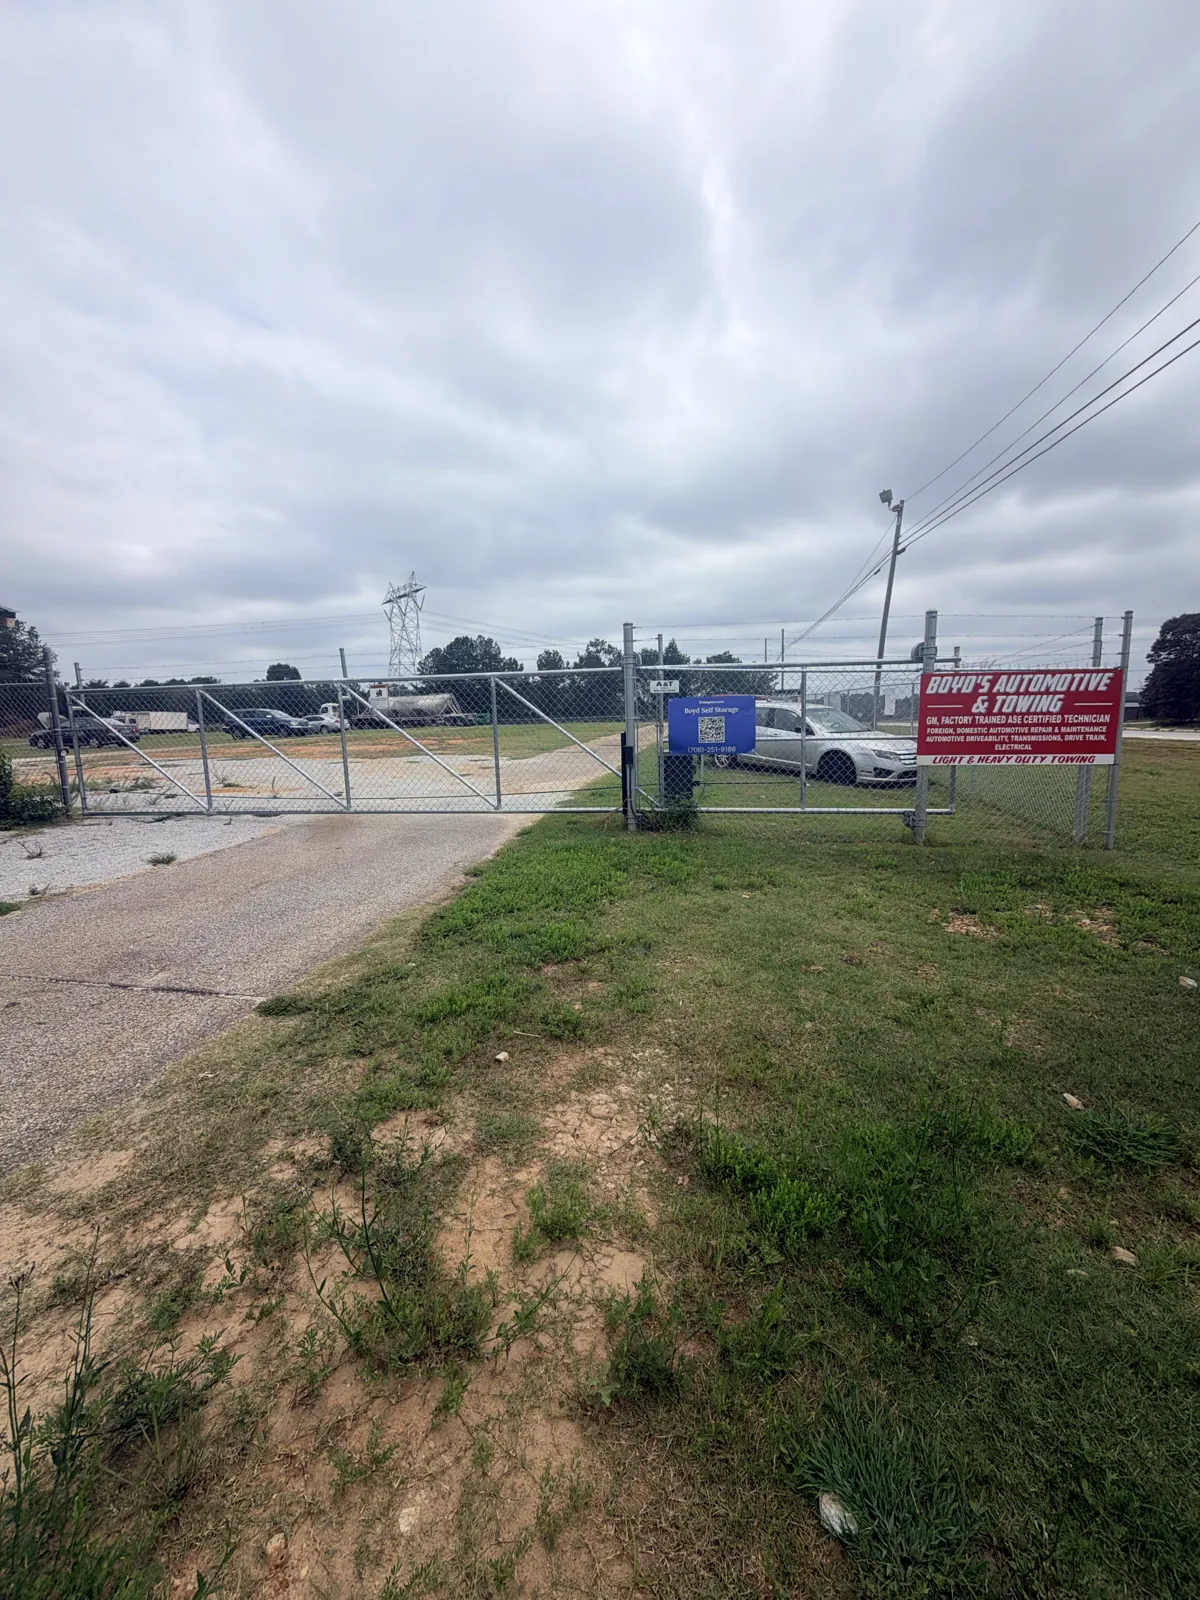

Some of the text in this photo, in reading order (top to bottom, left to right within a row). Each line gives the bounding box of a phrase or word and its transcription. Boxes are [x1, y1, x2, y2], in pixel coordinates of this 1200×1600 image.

[926, 672, 1114, 694] BOYD'S AUTOMOTIVE
[971, 695, 1065, 713] & TOWING
[684, 707, 700, 715] Boyd
[926, 714, 1110, 727] GM, FACTORY TRAINED ASE CERTIFIED TECHNICIAN
[966, 735, 1009, 743] DRIVEABILITY,
[977, 756, 1012, 764] HEAVY
[1015, 756, 1047, 764] DUTY
[1051, 756, 1095, 764] TOWING
